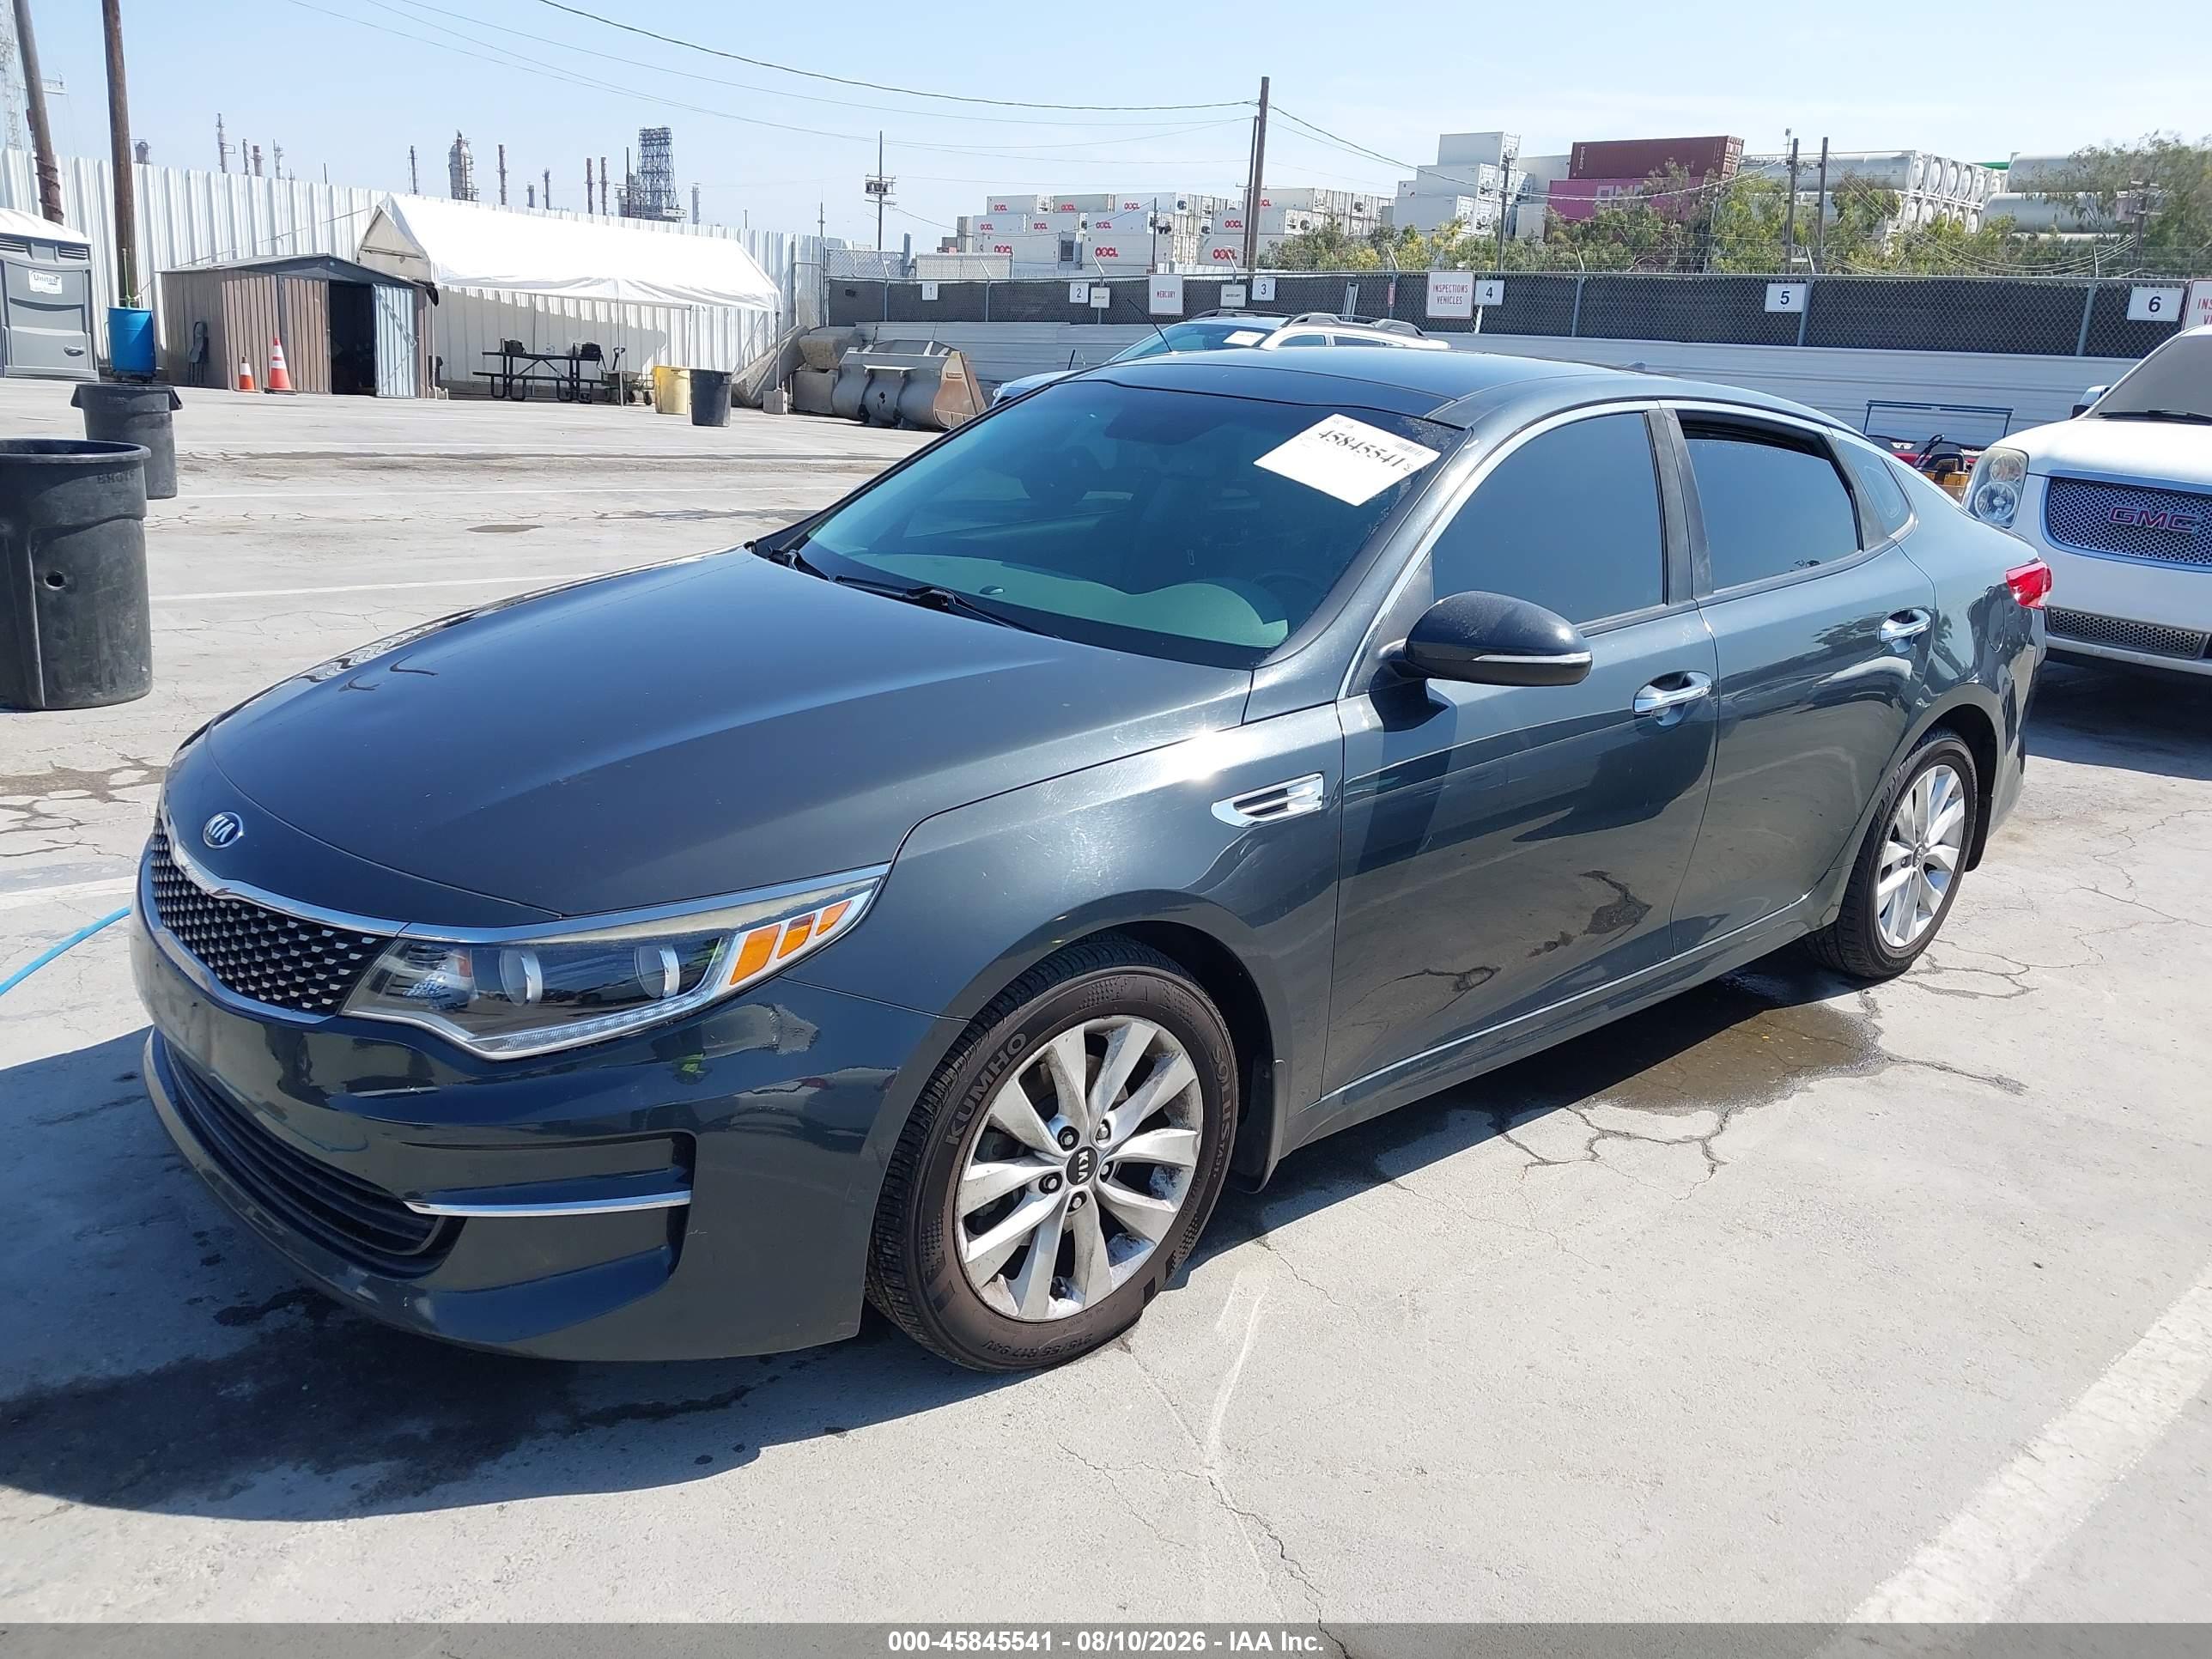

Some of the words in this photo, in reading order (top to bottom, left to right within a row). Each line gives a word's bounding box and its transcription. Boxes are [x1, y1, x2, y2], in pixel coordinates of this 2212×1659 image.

[994, 204, 1008, 212] OOCL
[1124, 202, 1140, 210] OOCL
[1033, 222, 1048, 230] OOCL
[1224, 220, 1243, 228] OOCL
[1095, 246, 1119, 258] OOCL
[1212, 248, 1237, 260] OOCL
[929, 287, 933, 295] 1
[1076, 287, 1082, 299] 2
[1156, 290, 1176, 299] MERCURY
[1261, 283, 1267, 295] 3
[1432, 283, 1468, 294] INSPECTIONS
[1486, 286, 1493, 299] 4
[1437, 296, 1462, 305] VEHICLES
[1780, 290, 1790, 305] 5
[2148, 295, 2161, 313] 6
[1317, 429, 1408, 468] 45845541
[2109, 506, 2200, 533] GMC
[206, 815, 235, 842] KIA
[944, 1033, 1027, 1146] KUMHO
[1212, 1048, 1231, 1141] SOLUS
[1077, 1150, 1089, 1182] KIA
